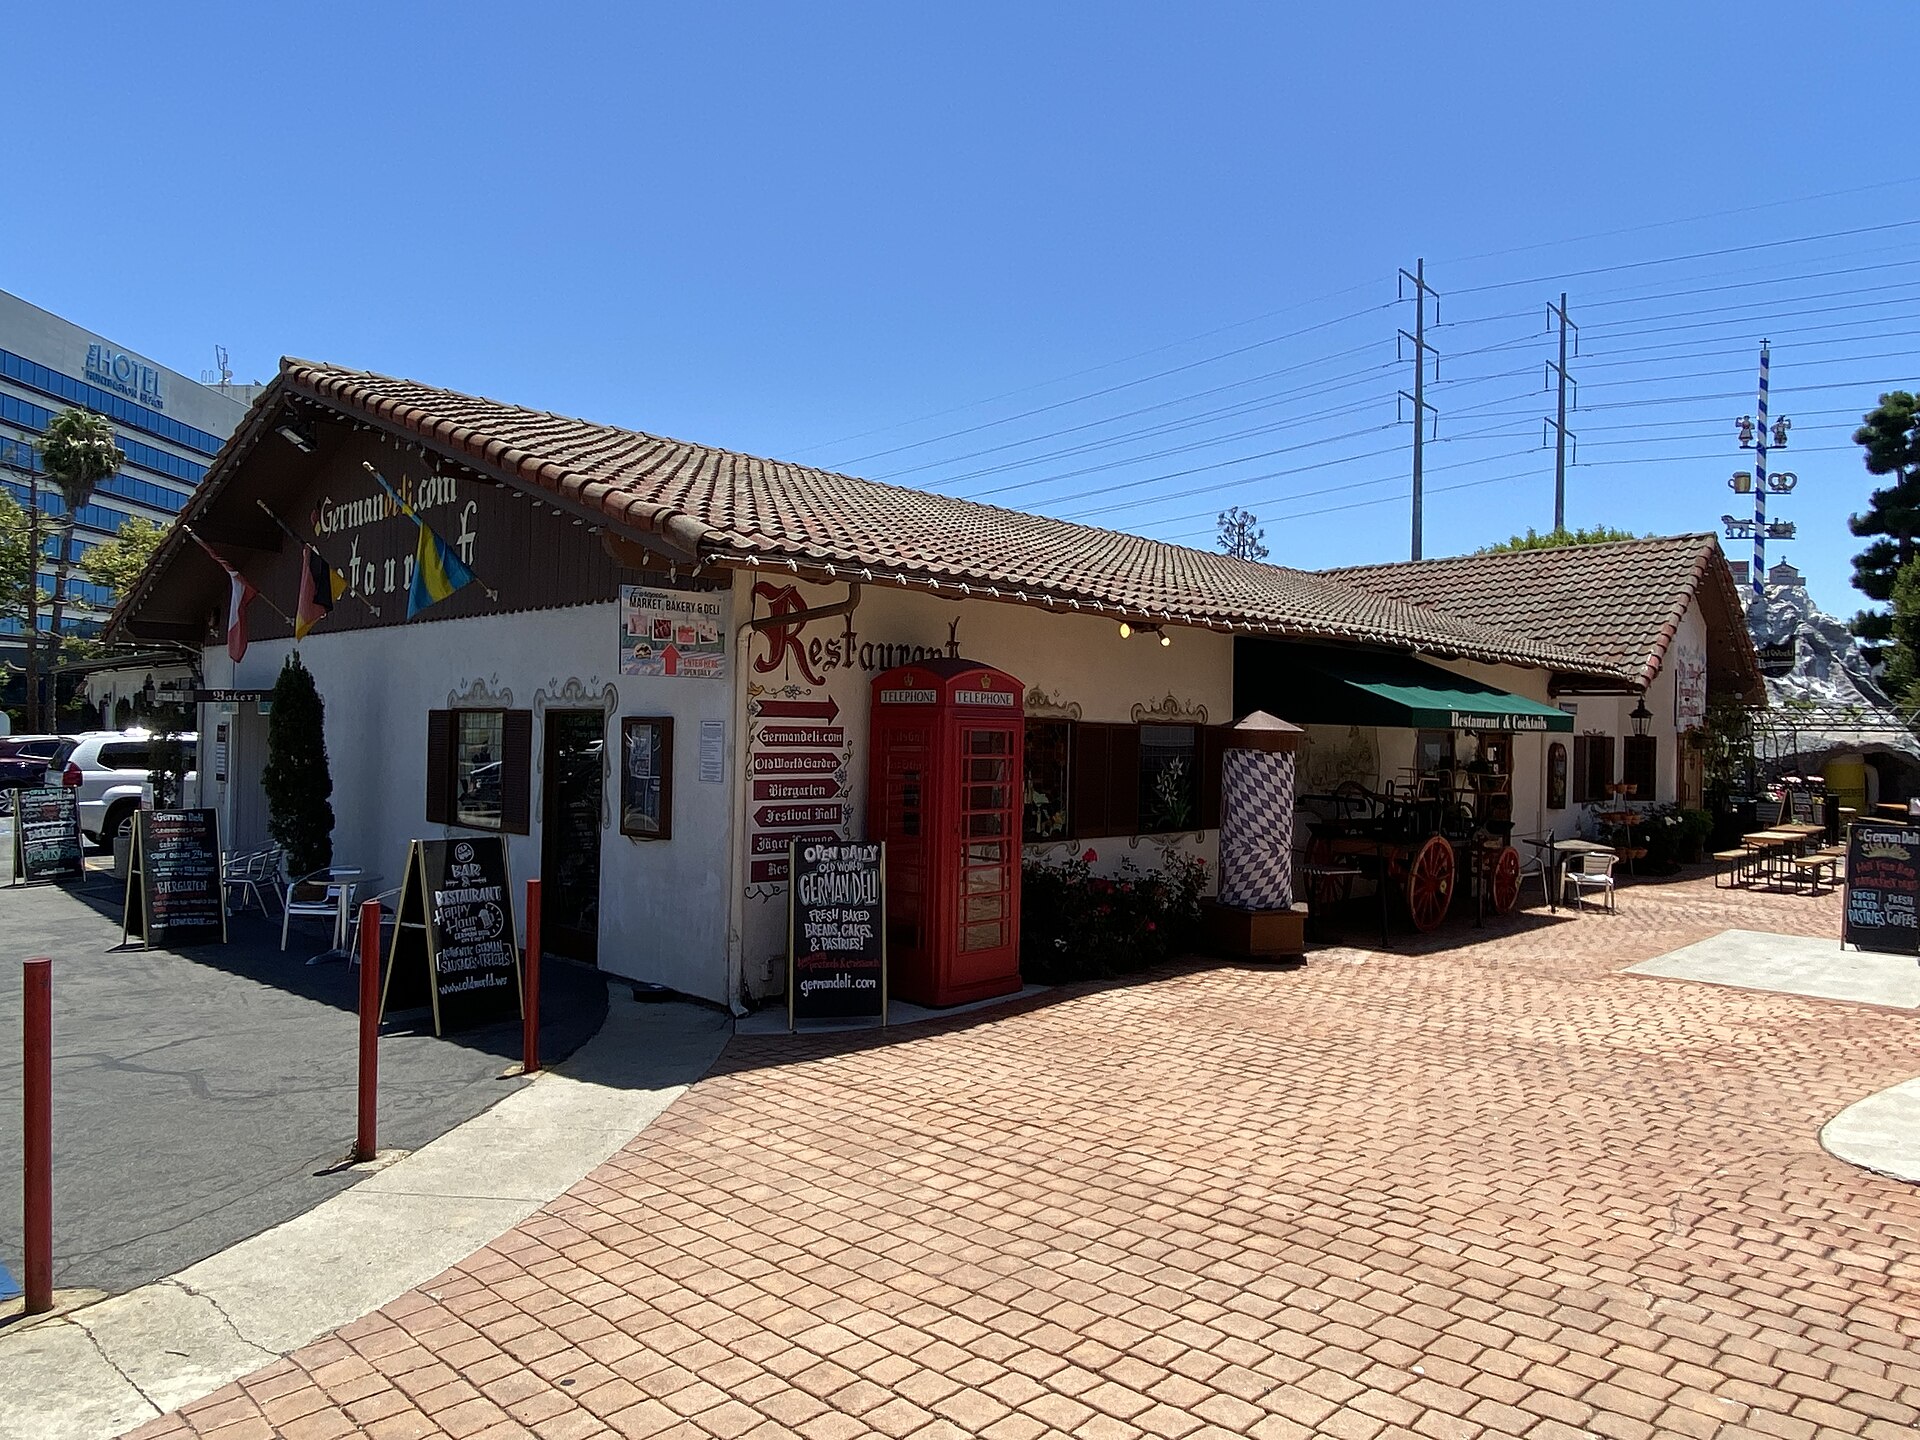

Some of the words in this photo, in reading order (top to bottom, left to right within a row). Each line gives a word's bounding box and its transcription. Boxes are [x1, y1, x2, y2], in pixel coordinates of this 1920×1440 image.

[97, 345, 162, 399] HOTEL
[666, 600, 695, 613] BAKERY
[697, 604, 703, 614] &
[704, 604, 720, 615] DELI
[683, 659, 702, 668] ENTER
[684, 668, 697, 676] OPEN
[213, 690, 262, 702] Bakery
[883, 690, 935, 702] TELEPHONE
[957, 691, 1011, 705] TELEPHONE
[1451, 711, 1500, 729] Restaurant
[1502, 714, 1511, 729] &
[1512, 714, 1548, 730] Cocktails
[759, 729, 843, 744] Germandeli.com
[754, 758, 774, 770] Old
[774, 757, 803, 770] World
[803, 758, 838, 770] Garden
[768, 784, 826, 799] Biergarten
[765, 809, 811, 822] Festival
[814, 807, 838, 820] Hall
[1863, 828, 1901, 844] German
[1901, 831, 1919, 845] Deli
[804, 844, 838, 863] OPEN
[840, 844, 879, 862] DAILY
[451, 863, 482, 878] BAR
[819, 863, 835, 873] OLD
[837, 861, 862, 873] WORLD
[156, 880, 207, 894] BIERGARTEN
[799, 872, 850, 906] GERMAN
[434, 885, 503, 907] RESTAURANT
[1852, 890, 1876, 901] FRESH
[1887, 893, 1914, 906] FRESH
[1851, 899, 1878, 910] BAKED
[433, 903, 471, 926] Happy
[808, 908, 839, 923] FRESH
[842, 910, 870, 923] BAKED
[1847, 908, 1886, 926] PASTRIES
[445, 916, 478, 935] Hour
[804, 922, 841, 938] BREADS,
[475, 939, 503, 954] GERMAN
[810, 937, 820, 952] &
[821, 935, 864, 951] PASTRIES!
[800, 973, 876, 997] germandeli.com
